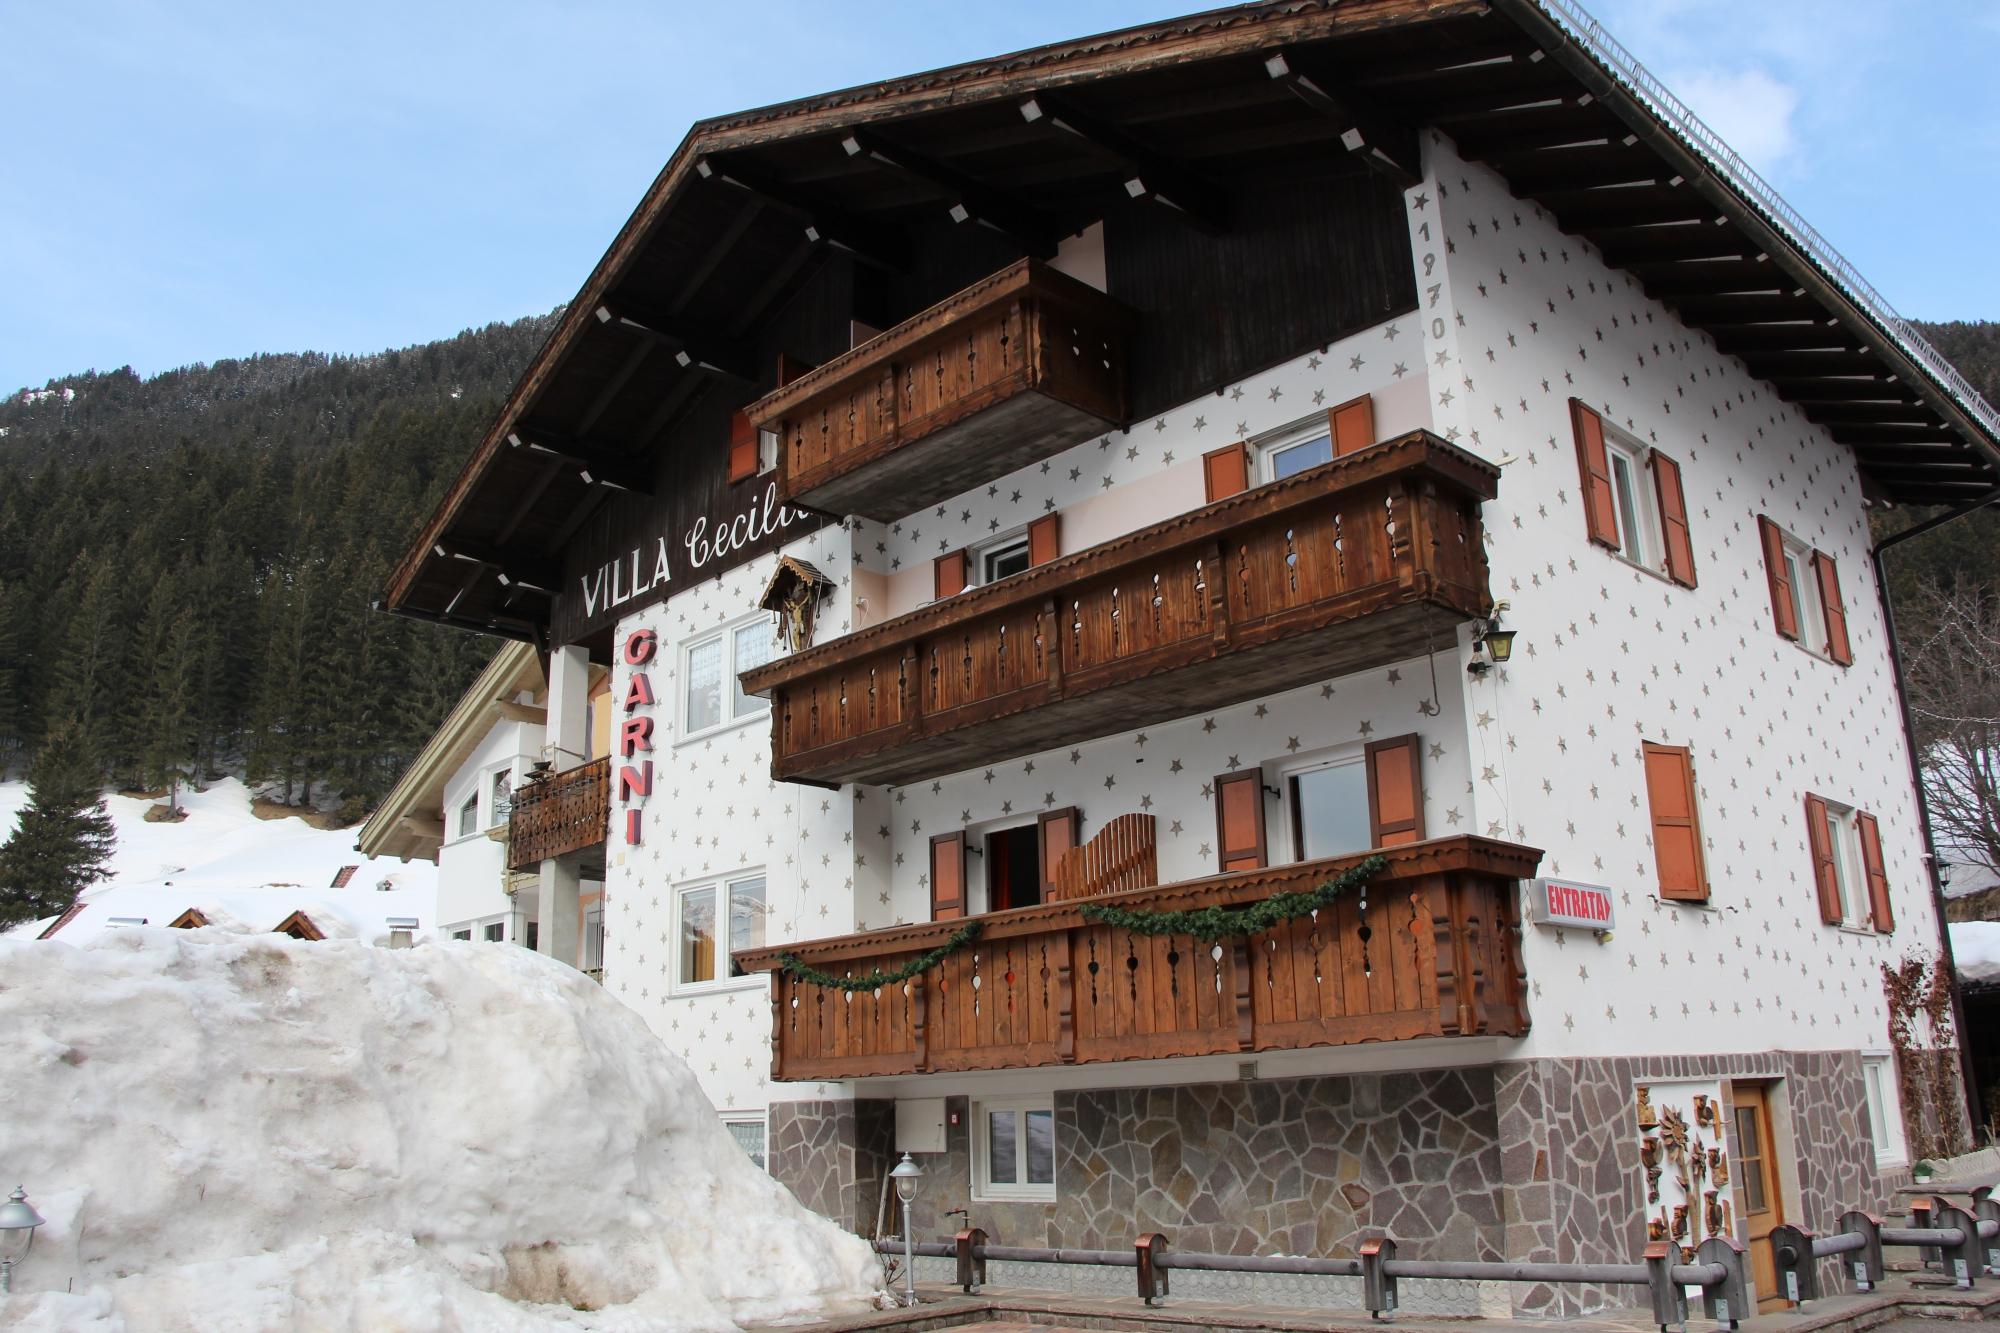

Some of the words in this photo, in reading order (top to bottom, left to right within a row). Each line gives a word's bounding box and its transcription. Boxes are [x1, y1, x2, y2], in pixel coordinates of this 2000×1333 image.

[1418, 222, 1445, 339] 1970
[580, 537, 671, 617] VILLA
[619, 629, 657, 845] GARNI
[1547, 885, 1606, 920] ENTRATA
